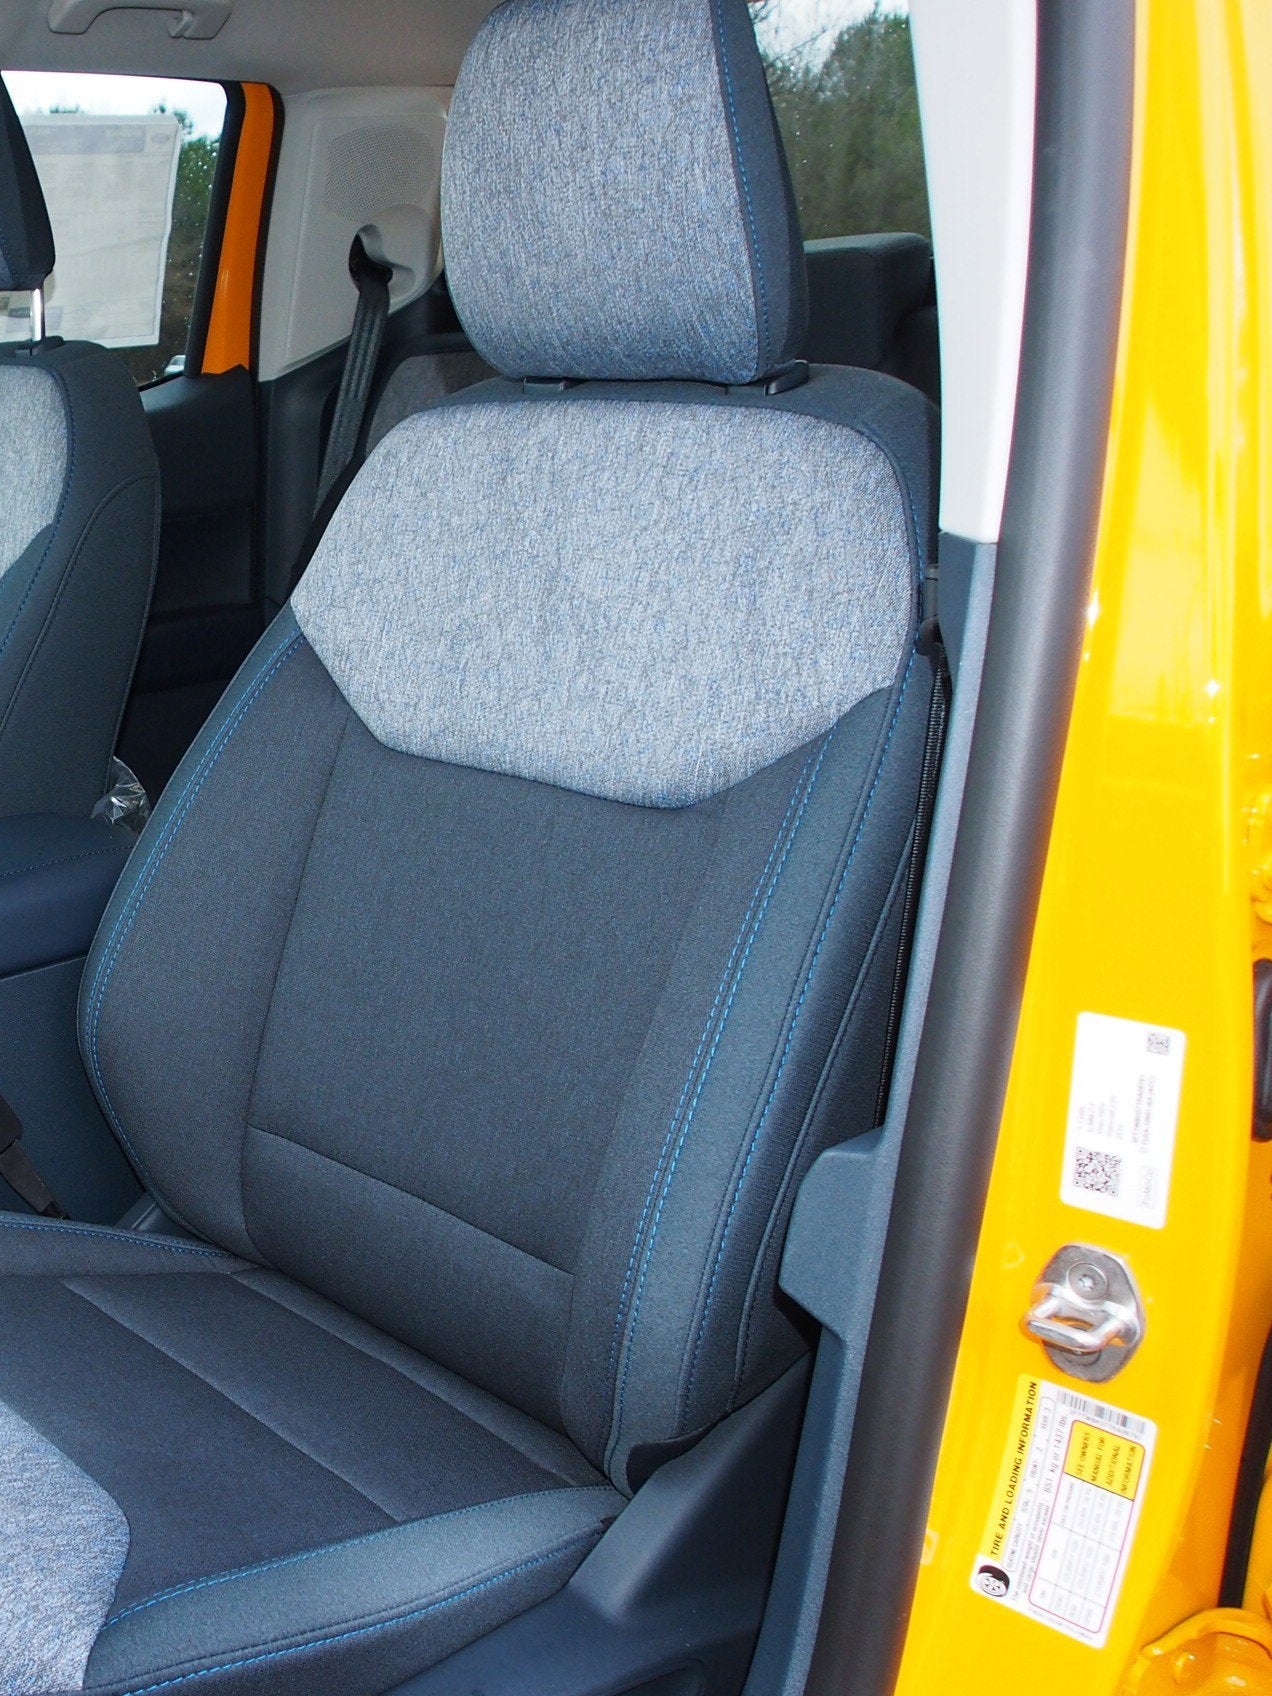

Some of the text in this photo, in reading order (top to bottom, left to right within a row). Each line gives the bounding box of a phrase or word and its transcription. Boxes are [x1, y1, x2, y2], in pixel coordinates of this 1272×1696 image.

[990, 1381, 1037, 1557] TIRE AND LOADING INFORMATION
[1089, 1453, 1102, 1482] MANUAL
[1104, 1444, 1121, 1486] ADDITIONAL
[1118, 1444, 1137, 1494] INFORMATION
